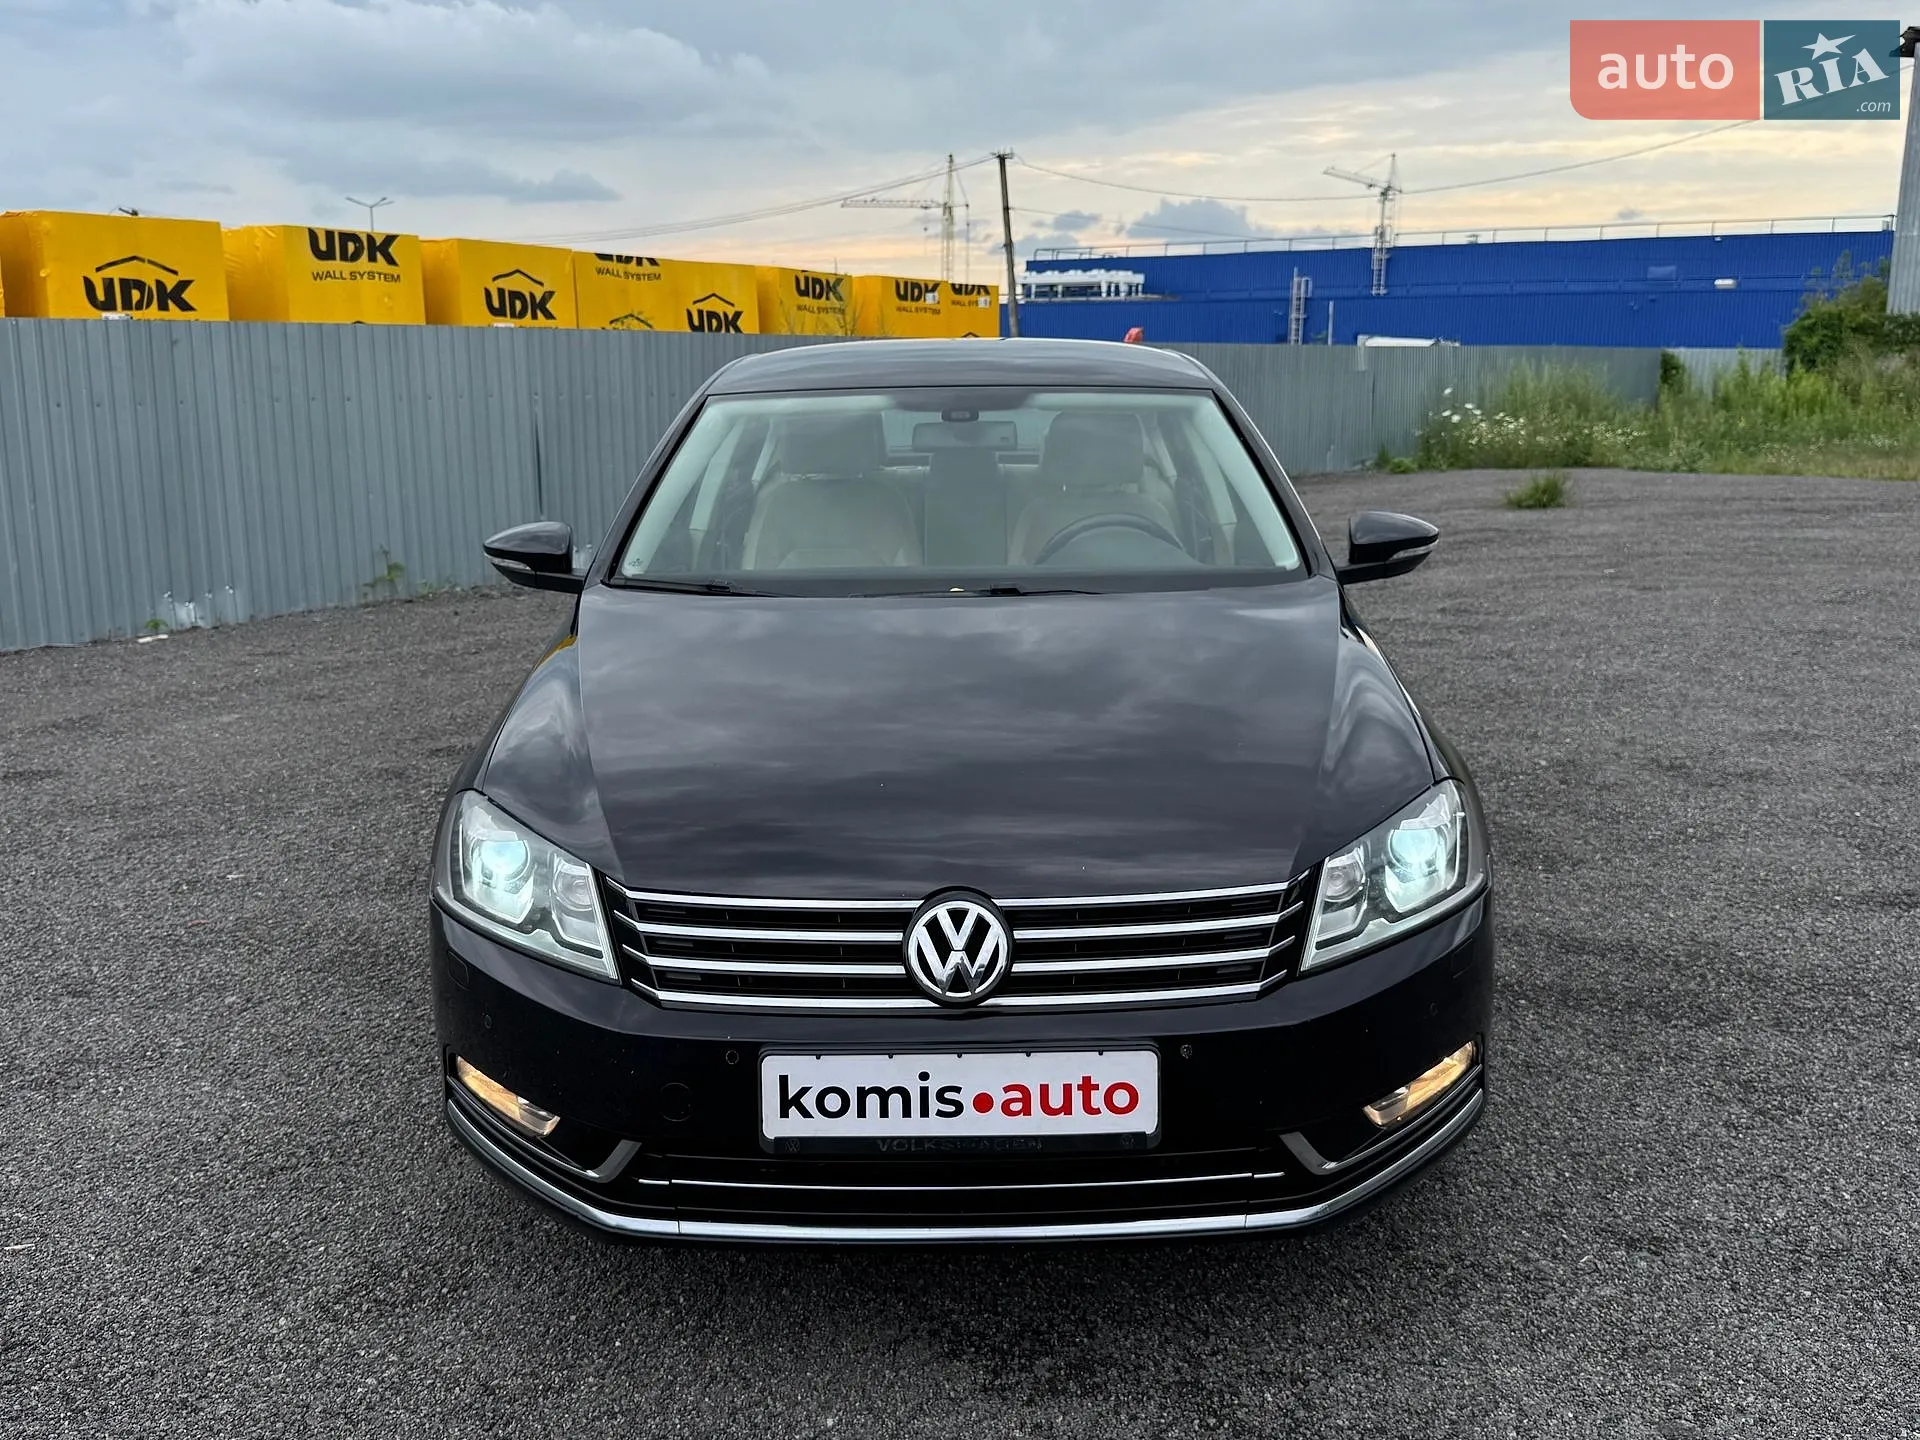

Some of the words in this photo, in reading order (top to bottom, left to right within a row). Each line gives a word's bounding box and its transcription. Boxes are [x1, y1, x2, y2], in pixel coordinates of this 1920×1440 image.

[308, 227, 400, 267] UDK
[312, 270, 347, 281] WALL
[349, 271, 401, 283] SYSTEM
[595, 266, 622, 278] WALL
[623, 271, 662, 281] SYSTEM
[83, 275, 197, 312] UDK
[795, 275, 845, 301] UDK
[484, 287, 557, 320] UDK
[686, 308, 744, 333] UDK
[876, 1138, 1043, 1152] VOLKSAGEN
